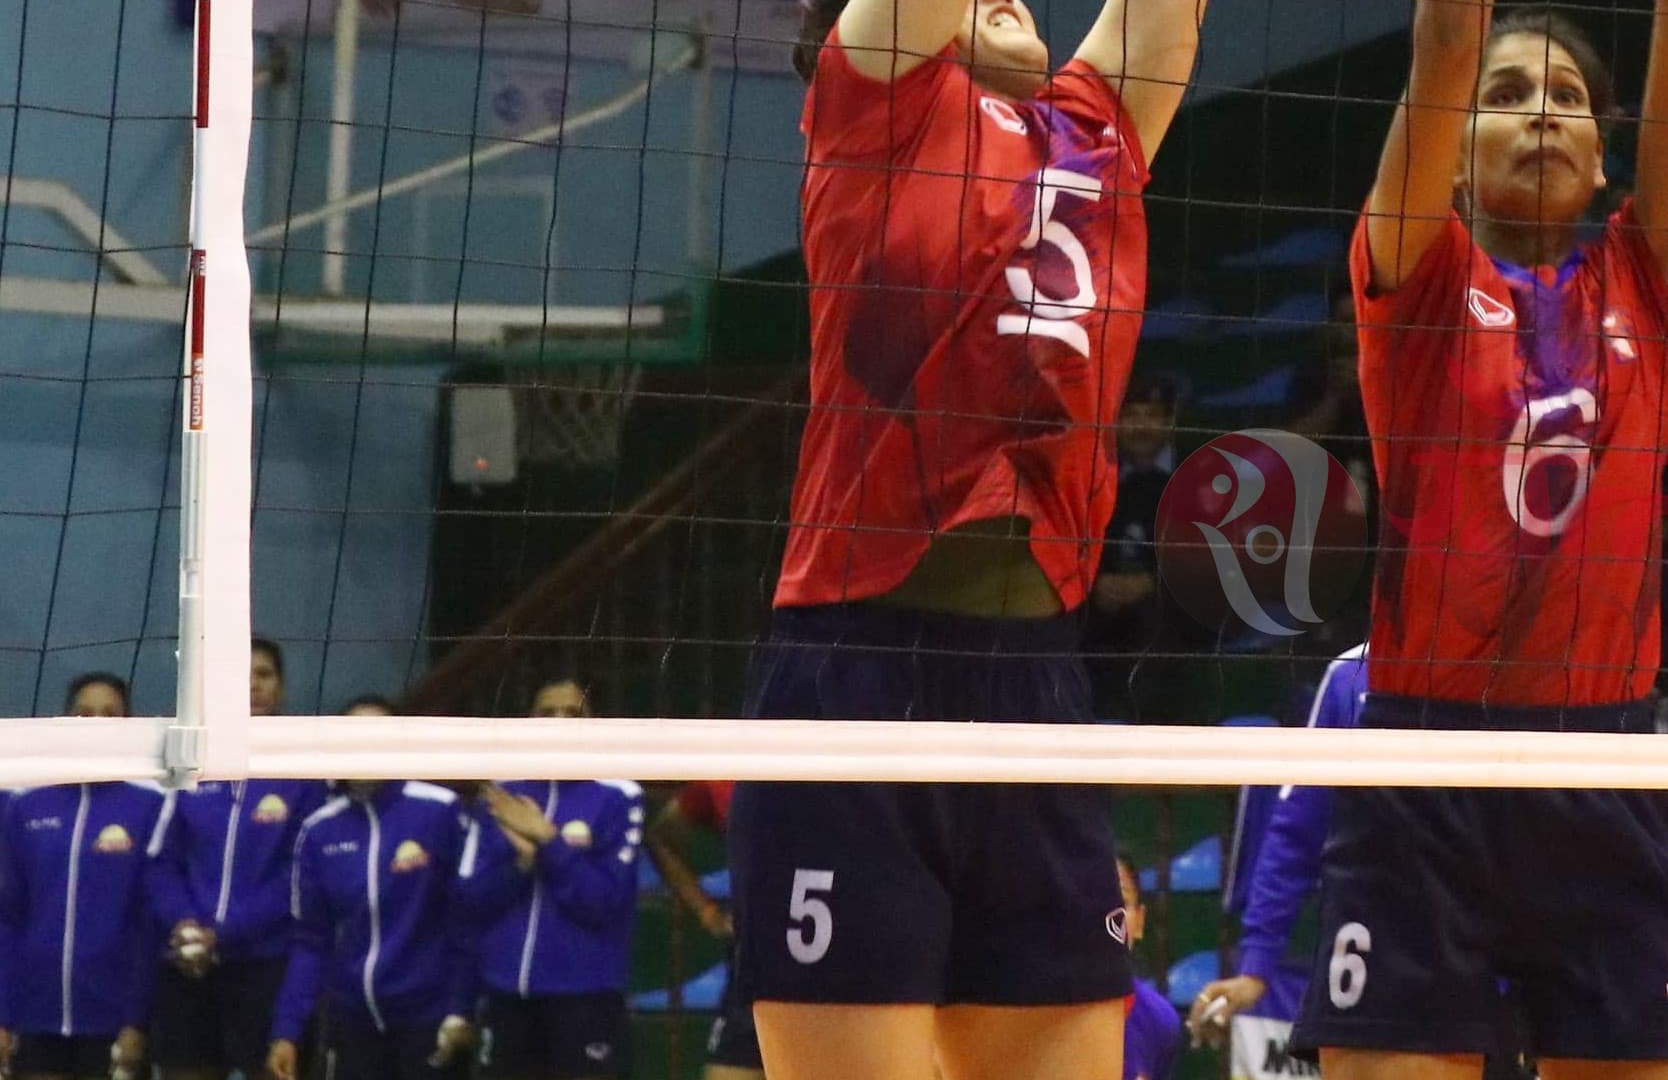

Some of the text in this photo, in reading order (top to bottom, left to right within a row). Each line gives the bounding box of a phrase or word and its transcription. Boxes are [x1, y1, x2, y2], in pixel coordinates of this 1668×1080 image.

[996, 167, 1103, 359] 5
[1502, 386, 1599, 538] 6
[785, 868, 835, 965] 5
[1328, 921, 1373, 1010] 6
